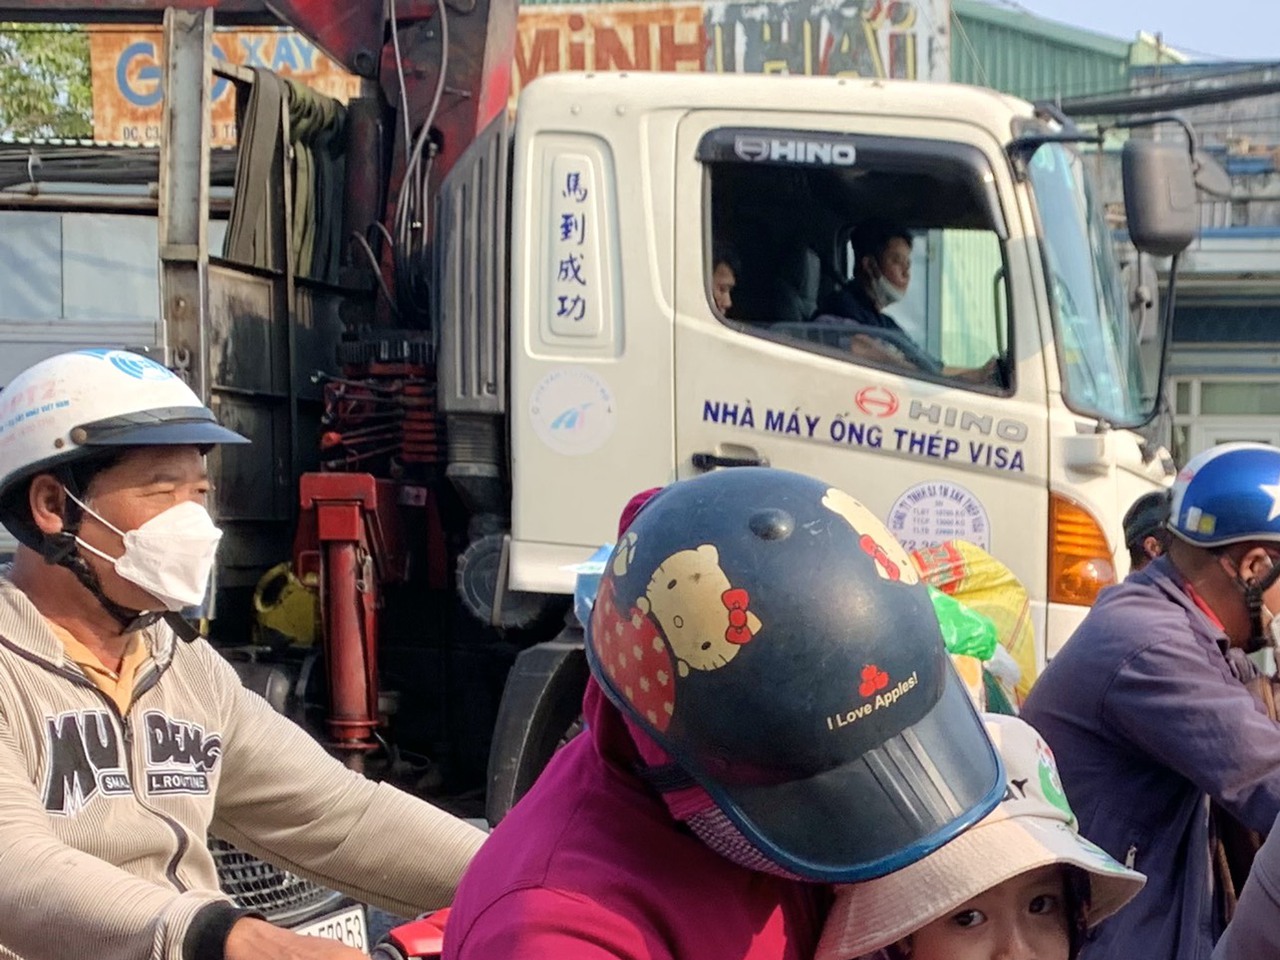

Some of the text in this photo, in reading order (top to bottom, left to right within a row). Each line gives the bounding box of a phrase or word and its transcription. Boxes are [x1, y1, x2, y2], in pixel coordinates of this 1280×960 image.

[770, 139, 856, 166] HINO
[556, 173, 588, 321] 馬到成功
[703, 399, 1025, 472] NHÀ MÁY ỐNG THÉP VISA
[909, 400, 1028, 442] HINO
[827, 671, 918, 730] I Love Apples!
